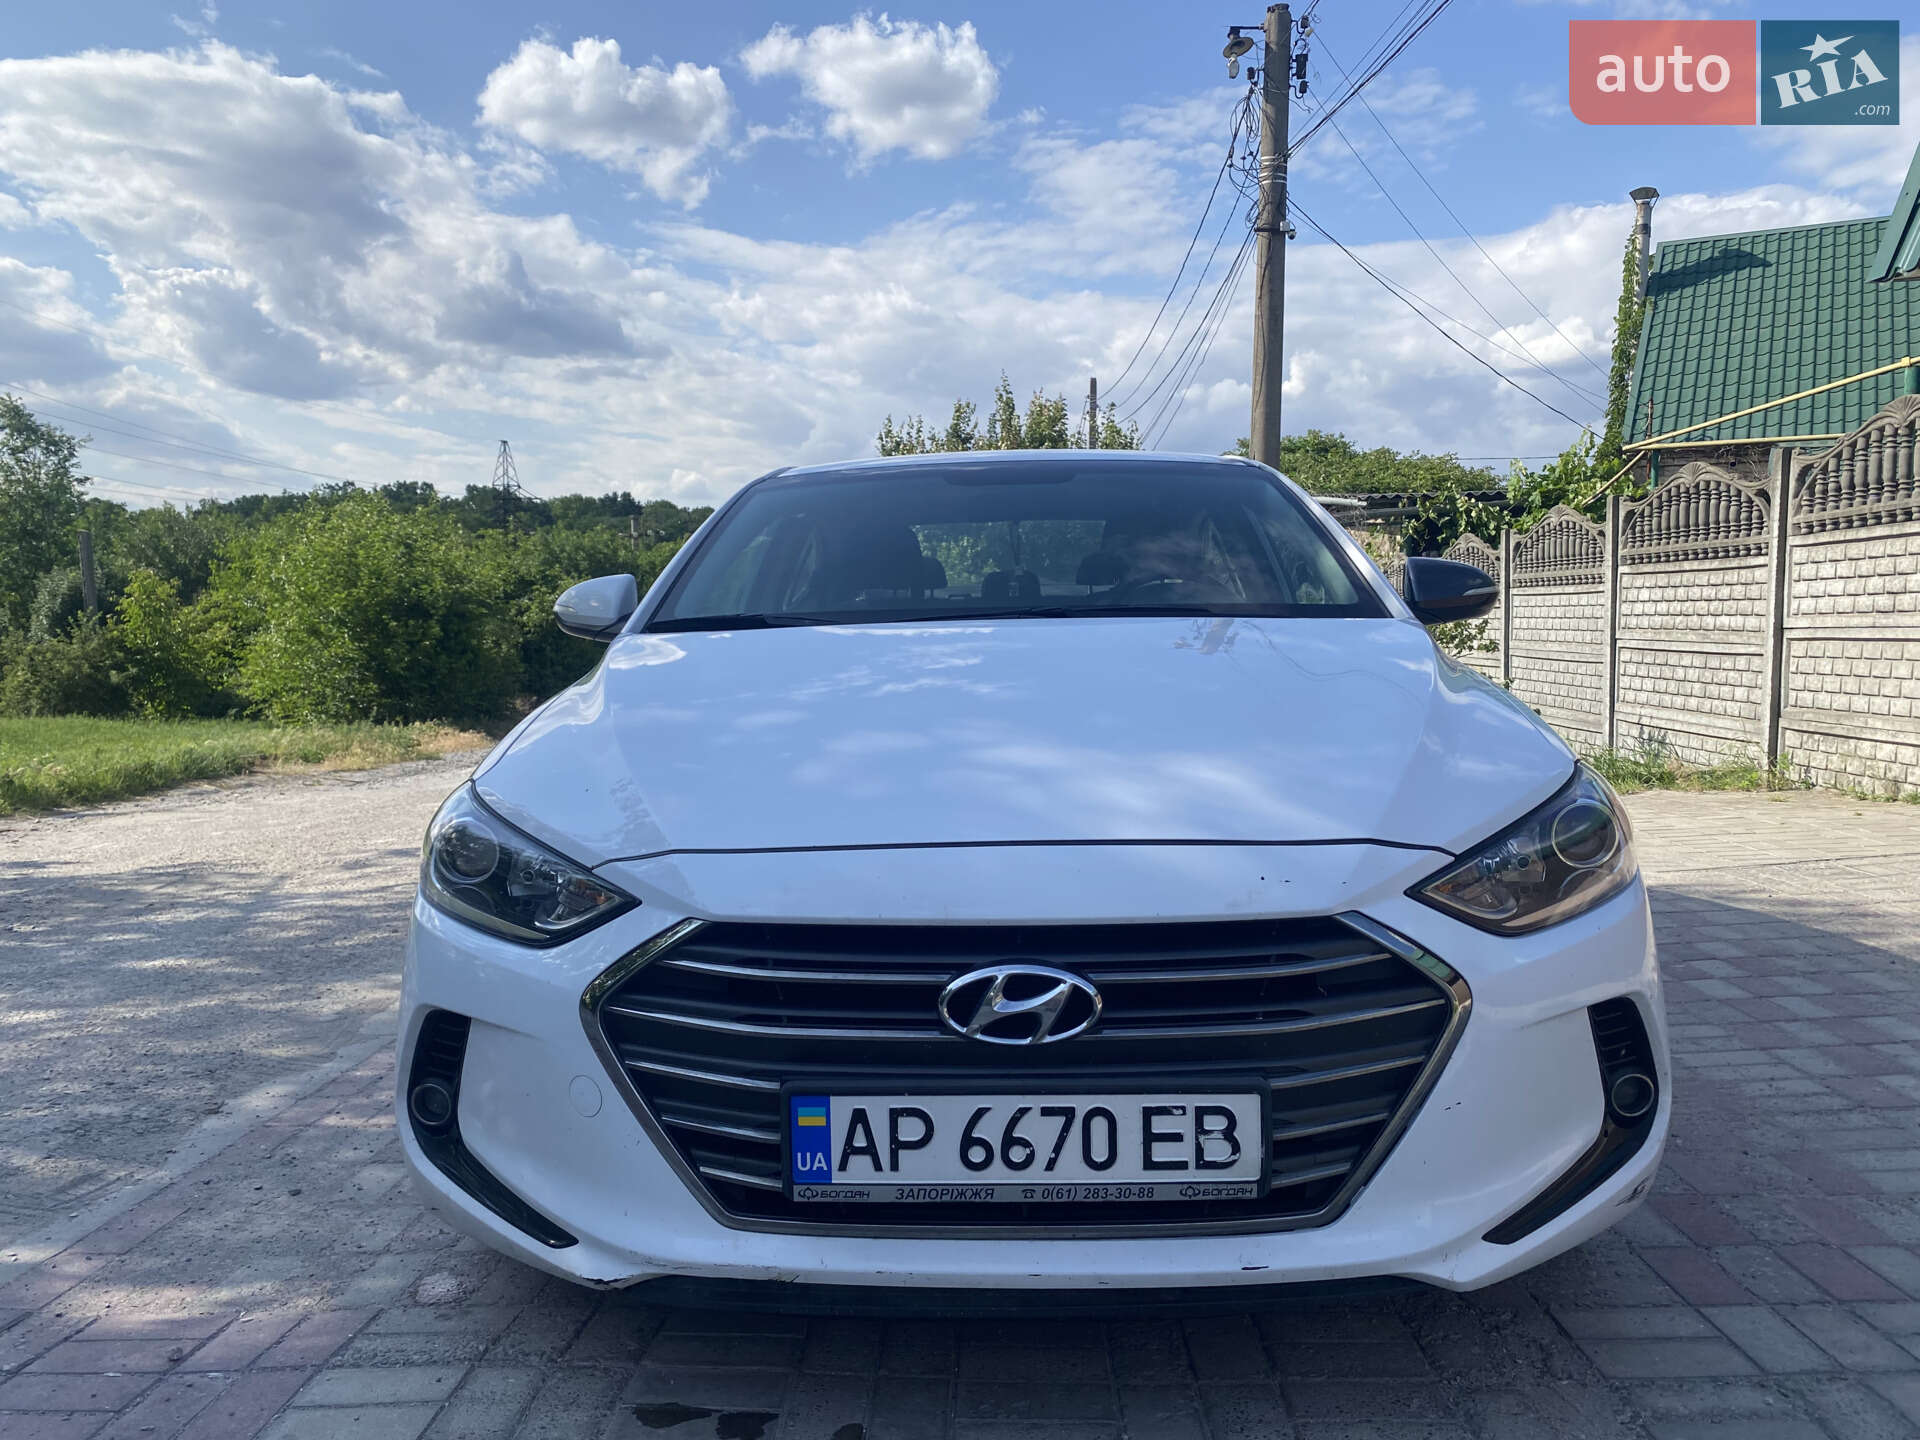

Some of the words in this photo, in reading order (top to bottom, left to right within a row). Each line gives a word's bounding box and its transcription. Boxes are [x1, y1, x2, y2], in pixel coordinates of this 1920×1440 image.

[837, 1106, 934, 1172] AP
[959, 1106, 1118, 1172] 6670
[1142, 1105, 1242, 1171] EB
[797, 1153, 828, 1171] UA
[895, 1187, 995, 1201] ЗАПОРІЖЖЯ
[1041, 1186, 1078, 1201] 0(61)
[1083, 1186, 1155, 1200] 283-30-88
